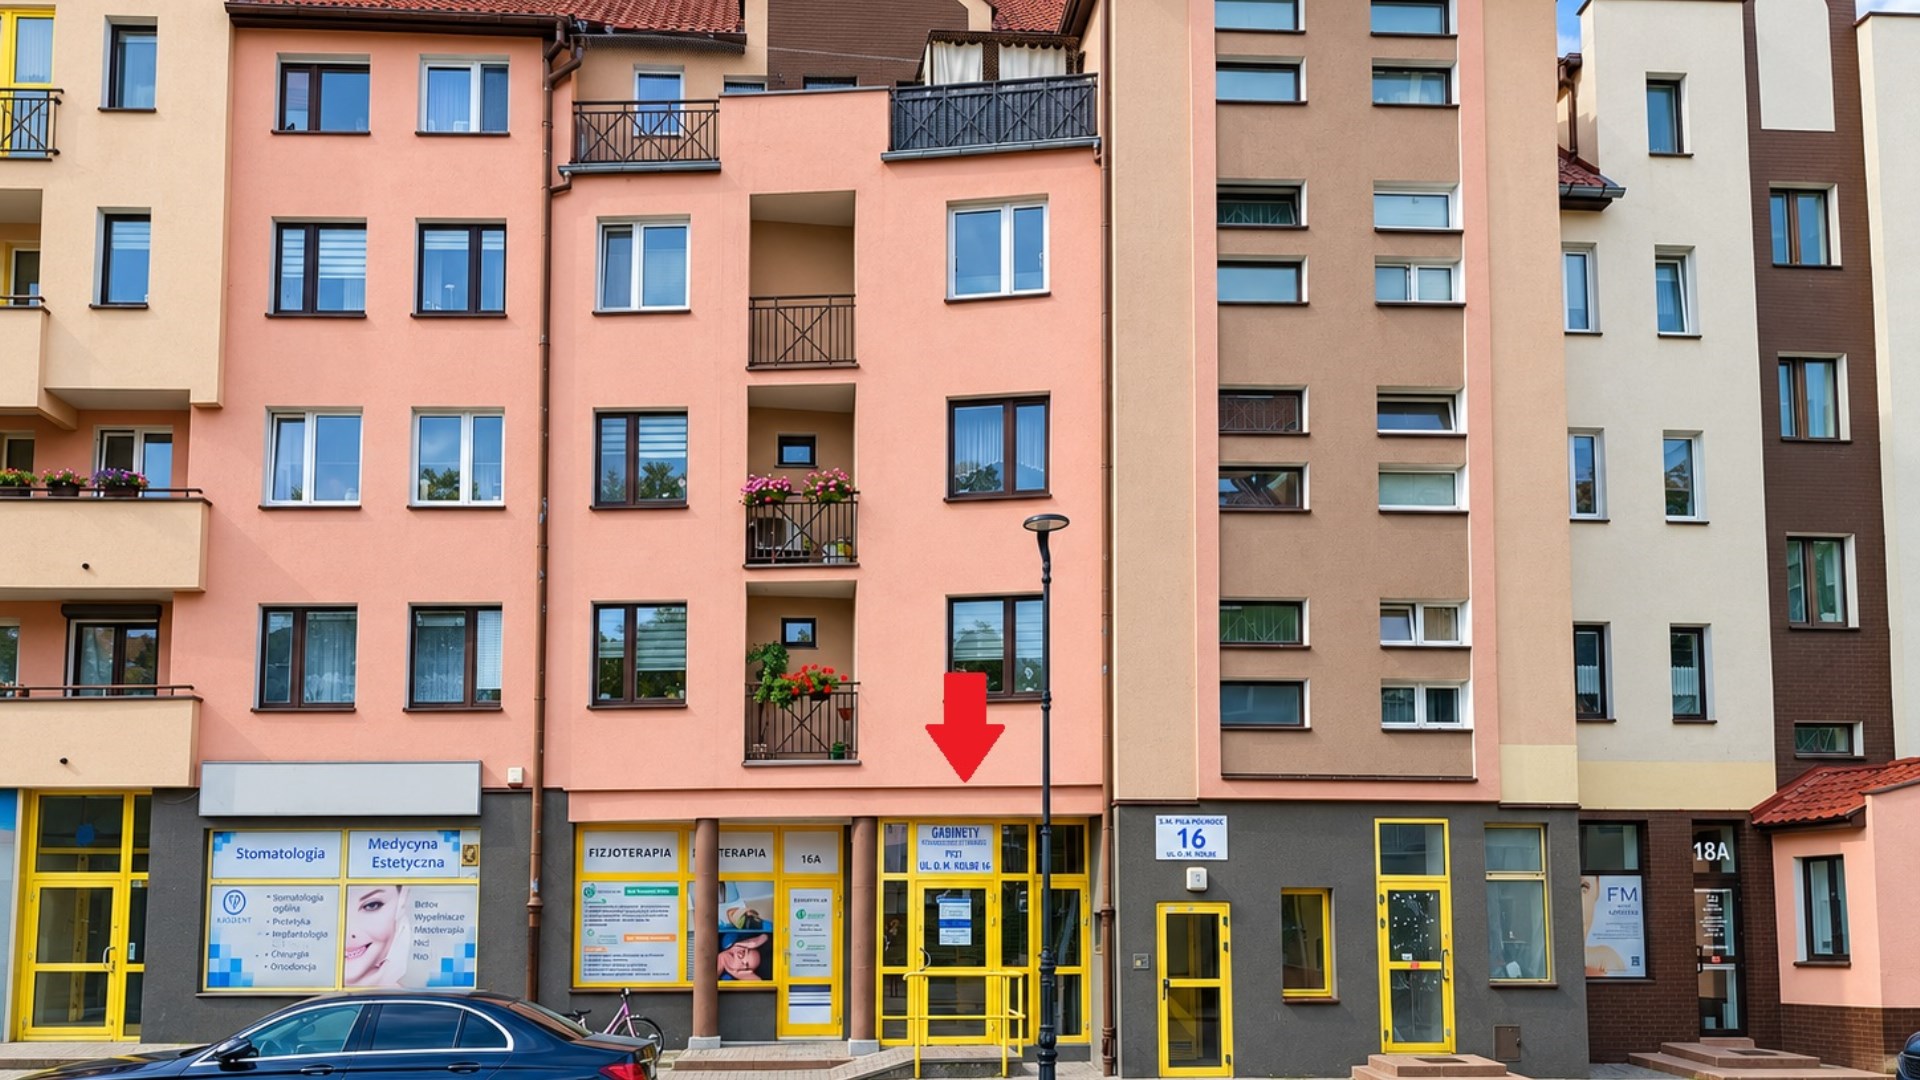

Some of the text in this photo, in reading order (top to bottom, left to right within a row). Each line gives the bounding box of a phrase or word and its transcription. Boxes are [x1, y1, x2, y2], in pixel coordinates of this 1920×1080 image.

[368, 837, 438, 853] Medycyna
[1177, 827, 1206, 849] 16
[236, 847, 326, 863] Stomatologia
[589, 848, 672, 858] FIZJOTERAPIA
[801, 854, 821, 864] 16A
[1693, 841, 1730, 861] 18A
[372, 856, 445, 871] Estetyczna
[1607, 886, 1638, 902] FM
